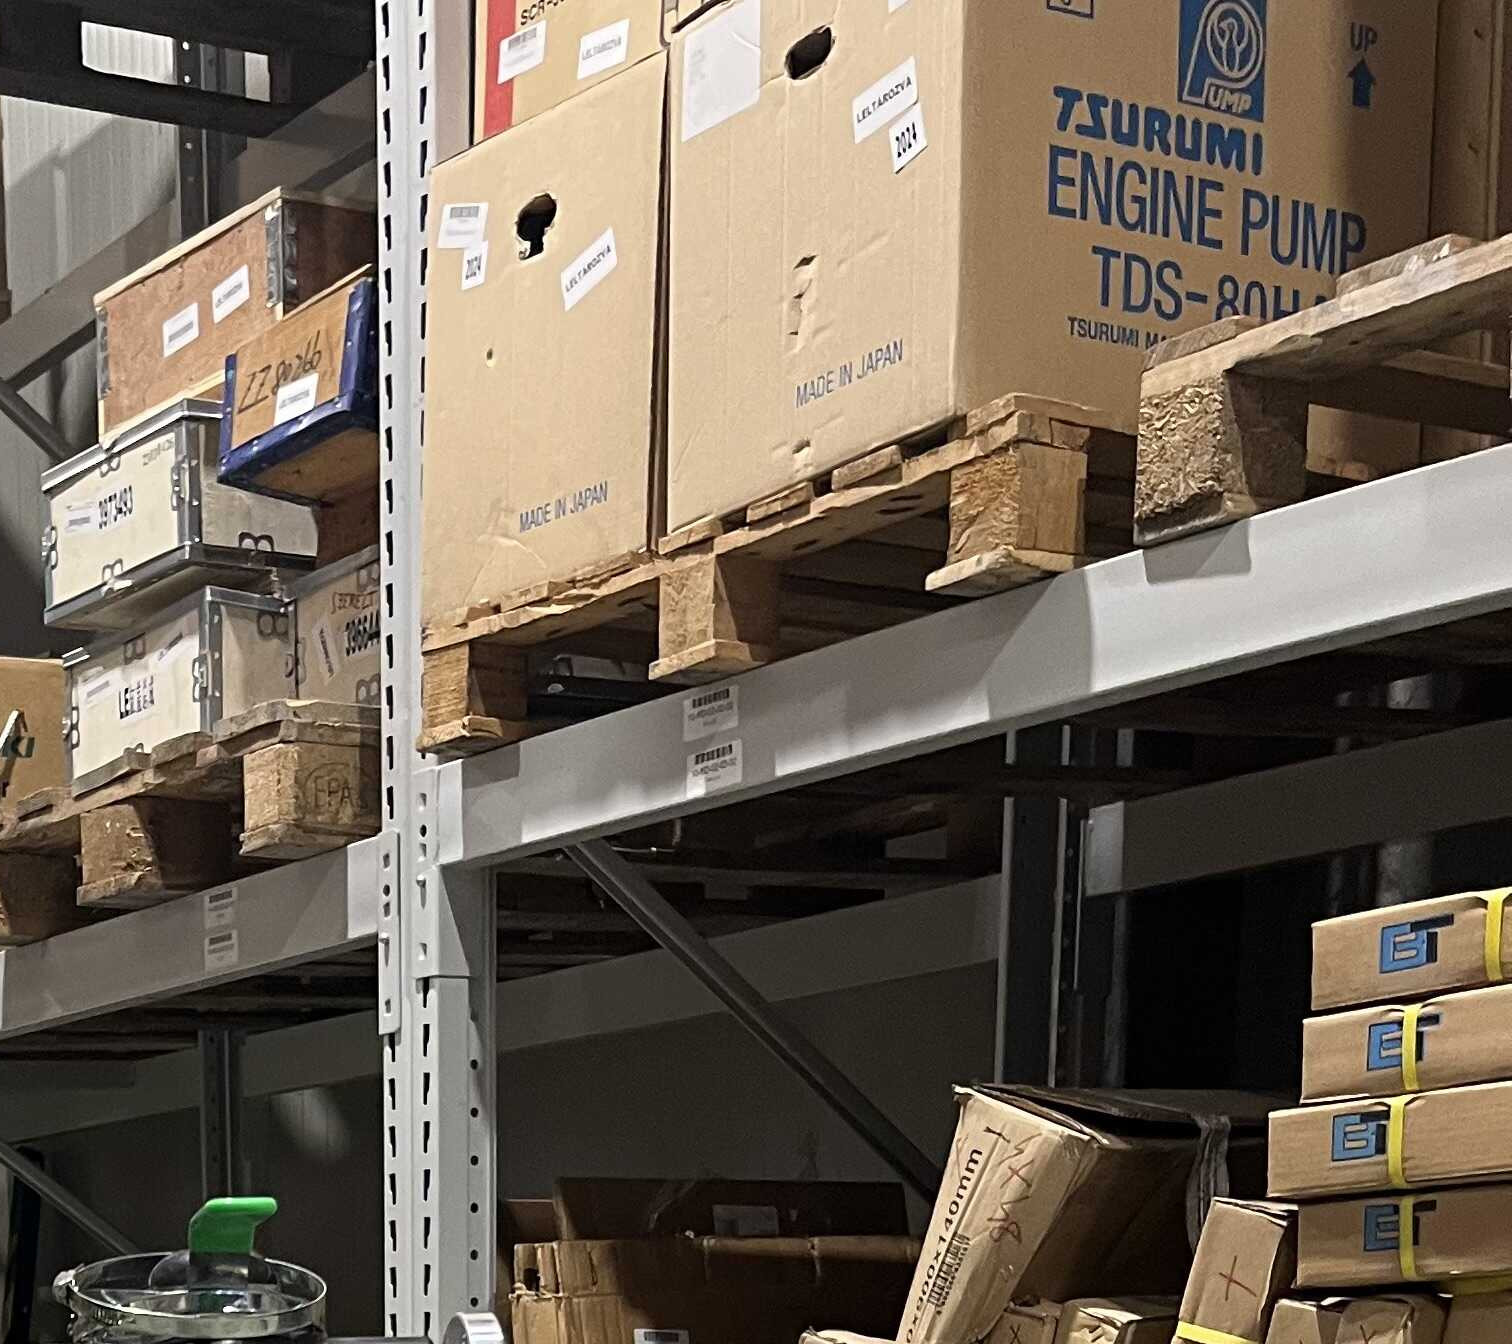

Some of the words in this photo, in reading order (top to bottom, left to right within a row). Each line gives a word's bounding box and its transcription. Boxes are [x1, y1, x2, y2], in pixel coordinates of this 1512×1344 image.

[1350, 22, 1378, 52] UP
[1051, 85, 1265, 177] TSURUMI
[1048, 143, 1226, 251] ENGINE
[1240, 187, 1367, 276] PUMP
[1067, 315, 1140, 348] TSURUMI
[795, 371, 835, 408] MADE
[838, 363, 853, 389] IN
[856, 338, 905, 379] JAPAN
[519, 502, 552, 534] MADE
[554, 498, 568, 521] IN
[569, 480, 609, 513] JAPAN
